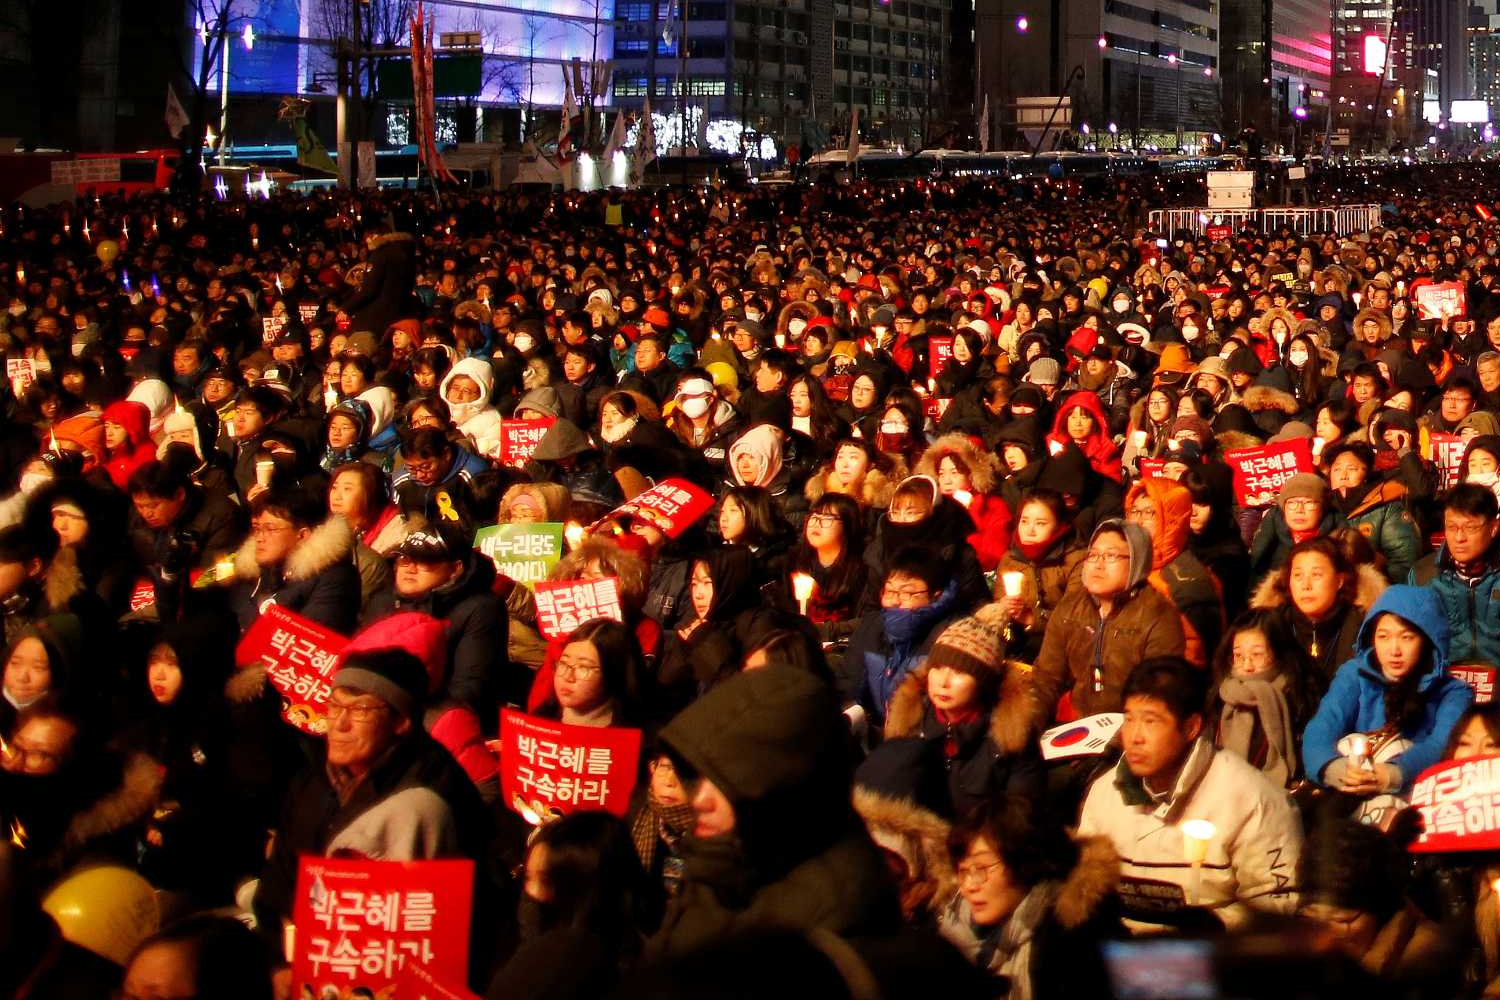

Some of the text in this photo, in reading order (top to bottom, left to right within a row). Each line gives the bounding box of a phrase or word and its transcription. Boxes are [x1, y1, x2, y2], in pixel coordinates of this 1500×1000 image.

[1240, 451, 1298, 476] 박근혜를
[534, 579, 618, 615] 박근혜를
[518, 734, 613, 775] 박근혜를
[517, 765, 611, 806] 구속하라
[310, 890, 437, 933] 박근혜를
